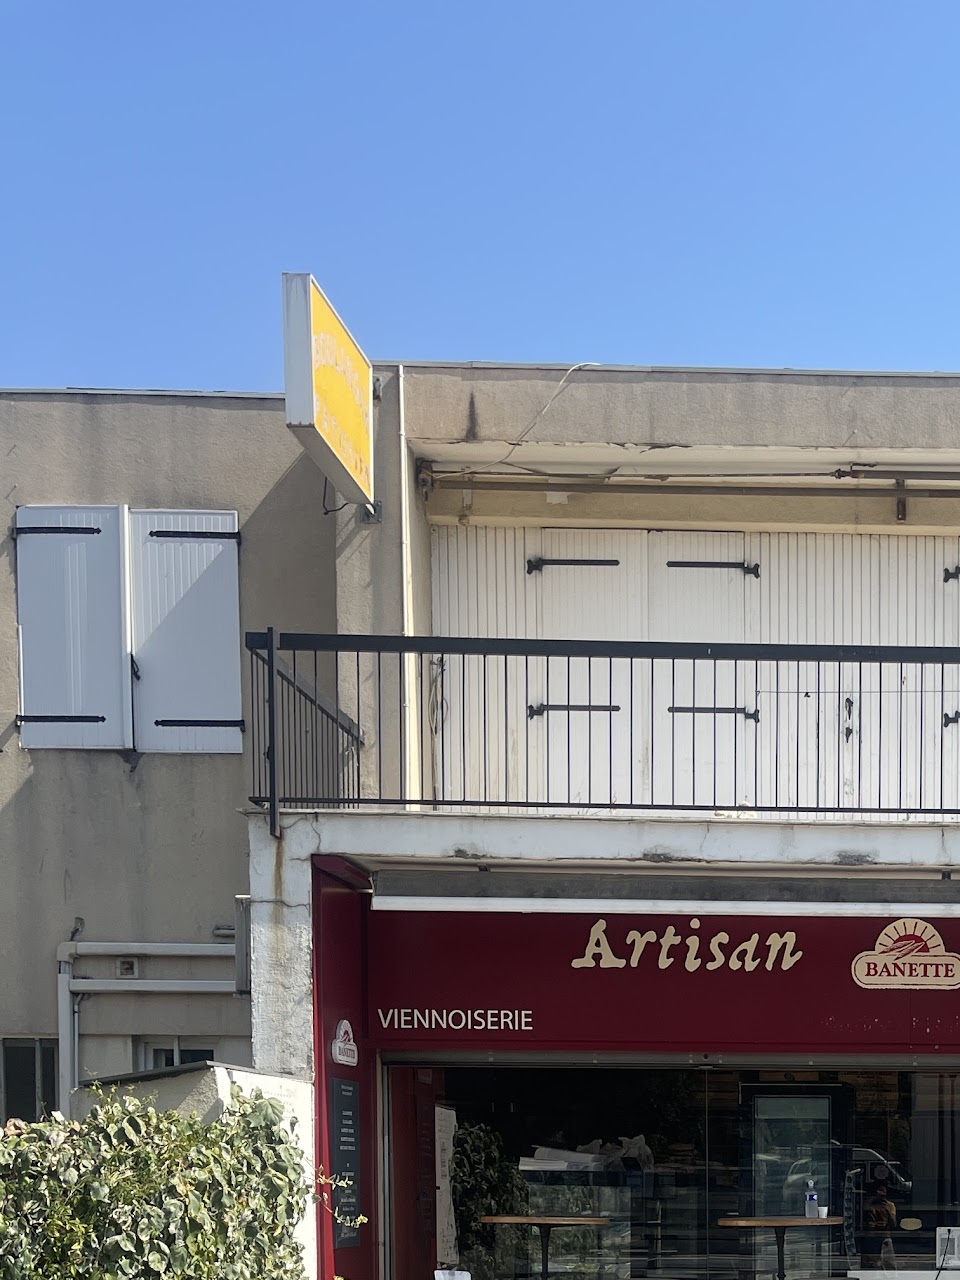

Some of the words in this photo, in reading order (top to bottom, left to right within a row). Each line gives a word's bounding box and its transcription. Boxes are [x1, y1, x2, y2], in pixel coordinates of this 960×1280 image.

[570, 918, 803, 972] Artisan
[864, 961, 956, 979] BANETTE
[377, 1008, 534, 1031] VIENNOISERIE
